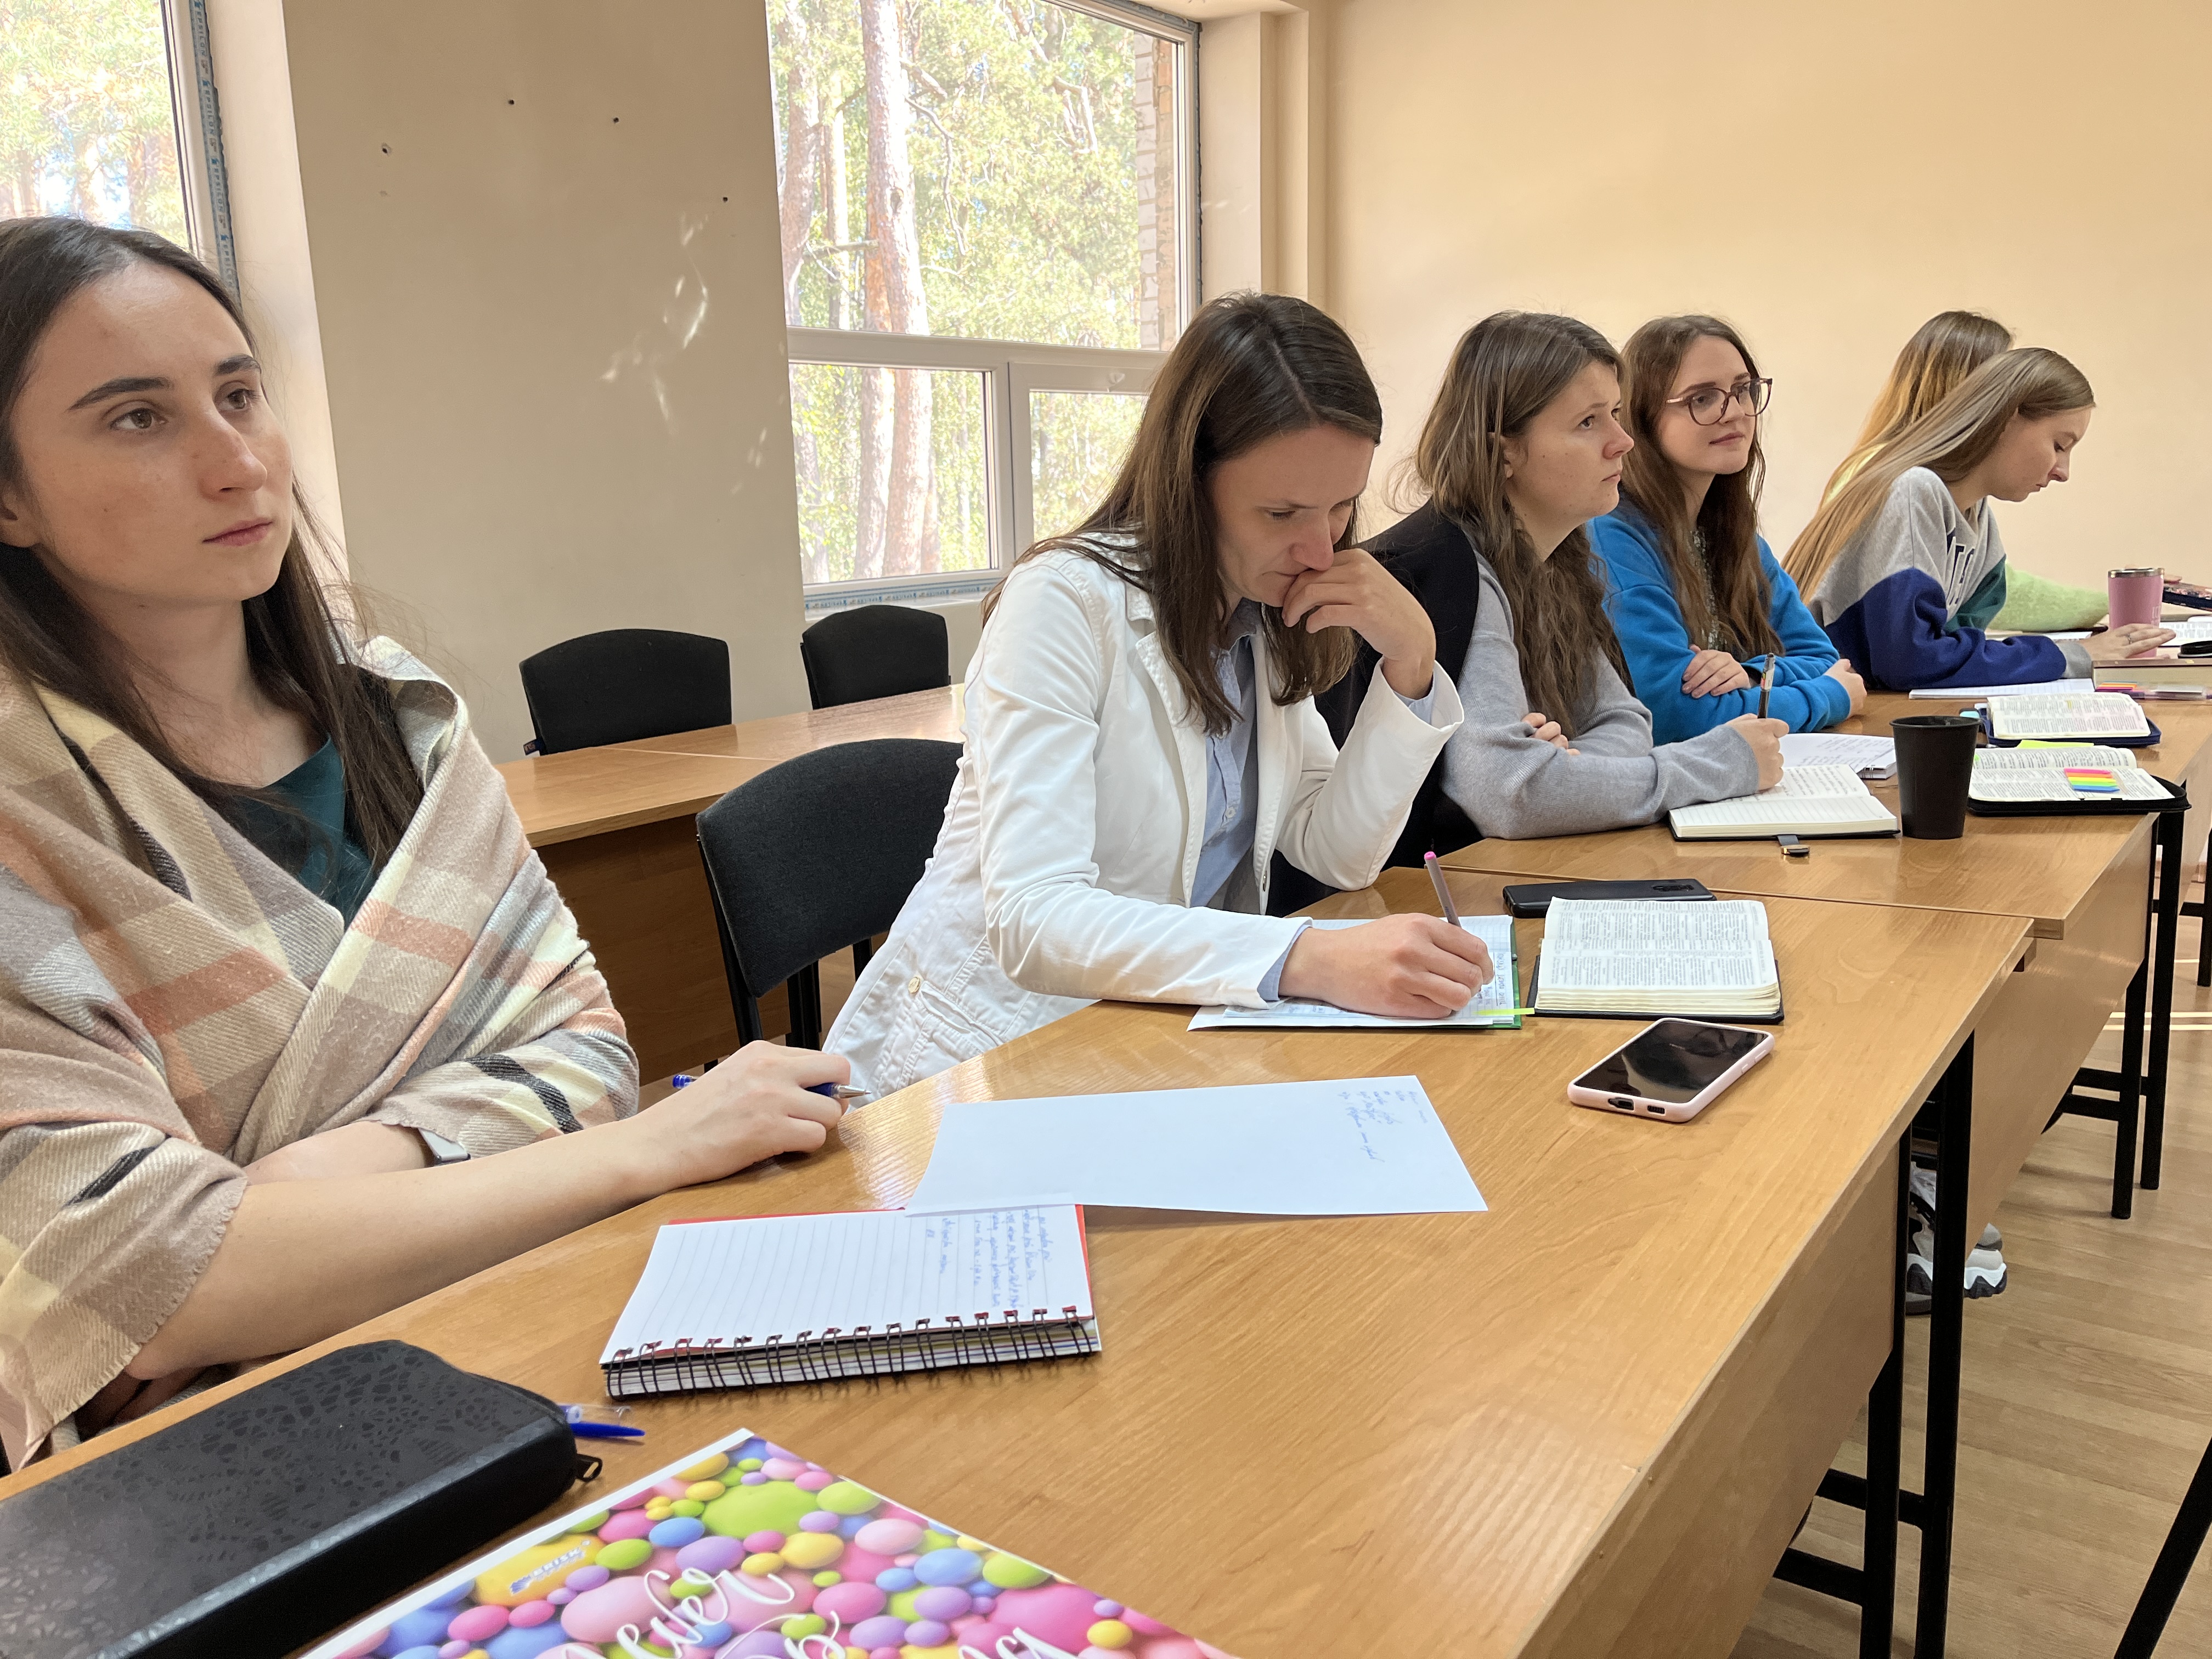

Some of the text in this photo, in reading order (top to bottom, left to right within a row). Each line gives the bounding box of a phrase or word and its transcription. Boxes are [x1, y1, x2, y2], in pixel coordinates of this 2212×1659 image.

[197, 11, 205, 55] EPSILON
[205, 89, 214, 134] EPSILON
[532, 1547, 580, 1577] BRISK
[561, 1566, 795, 1659] ever
